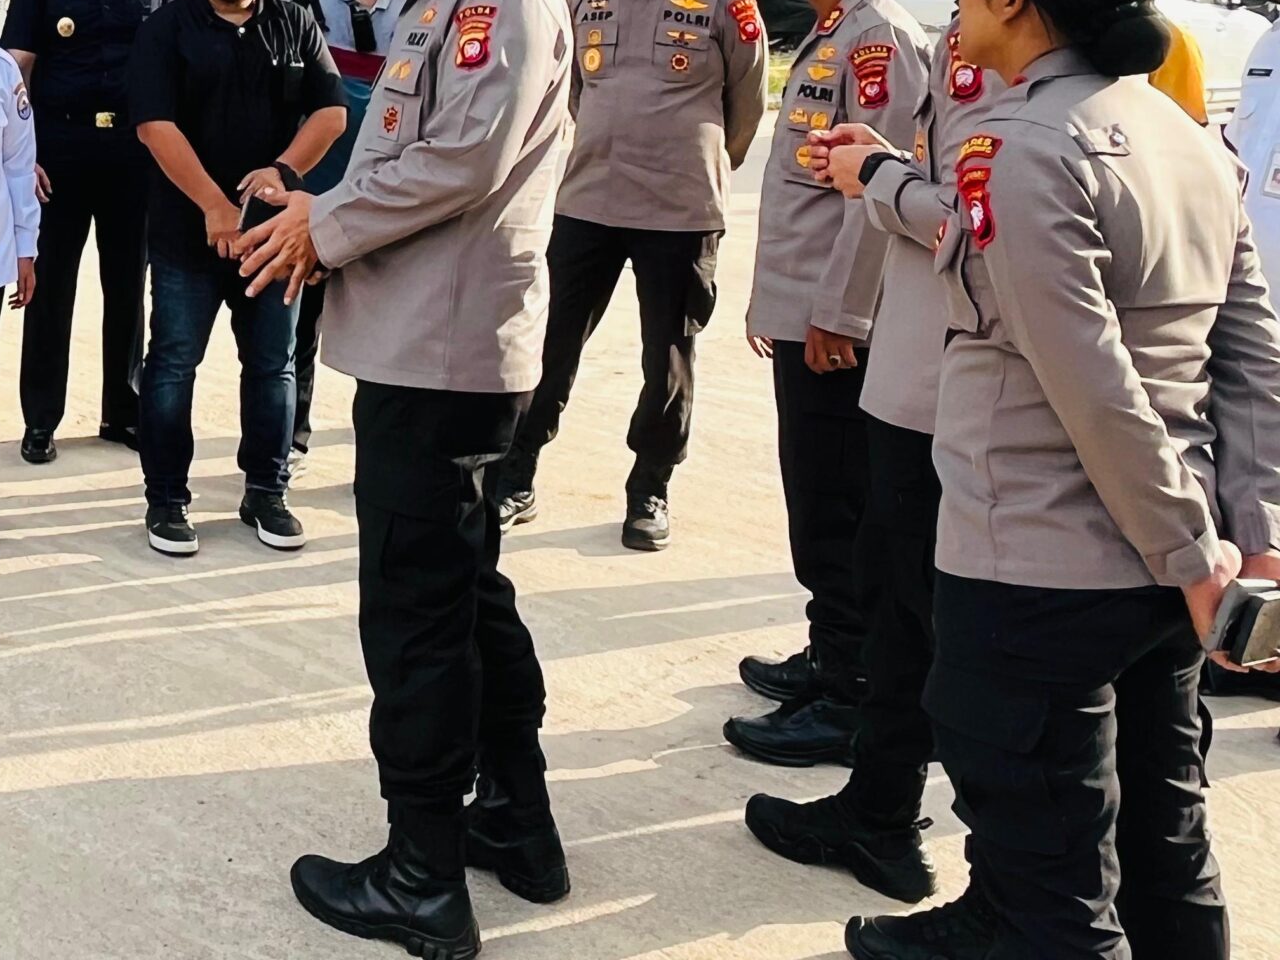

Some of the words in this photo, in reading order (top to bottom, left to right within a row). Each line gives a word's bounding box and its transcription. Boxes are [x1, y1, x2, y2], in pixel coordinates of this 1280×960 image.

[581, 10, 614, 23] ASEP
[663, 9, 710, 28] POLRI
[797, 83, 834, 103] POLRI
